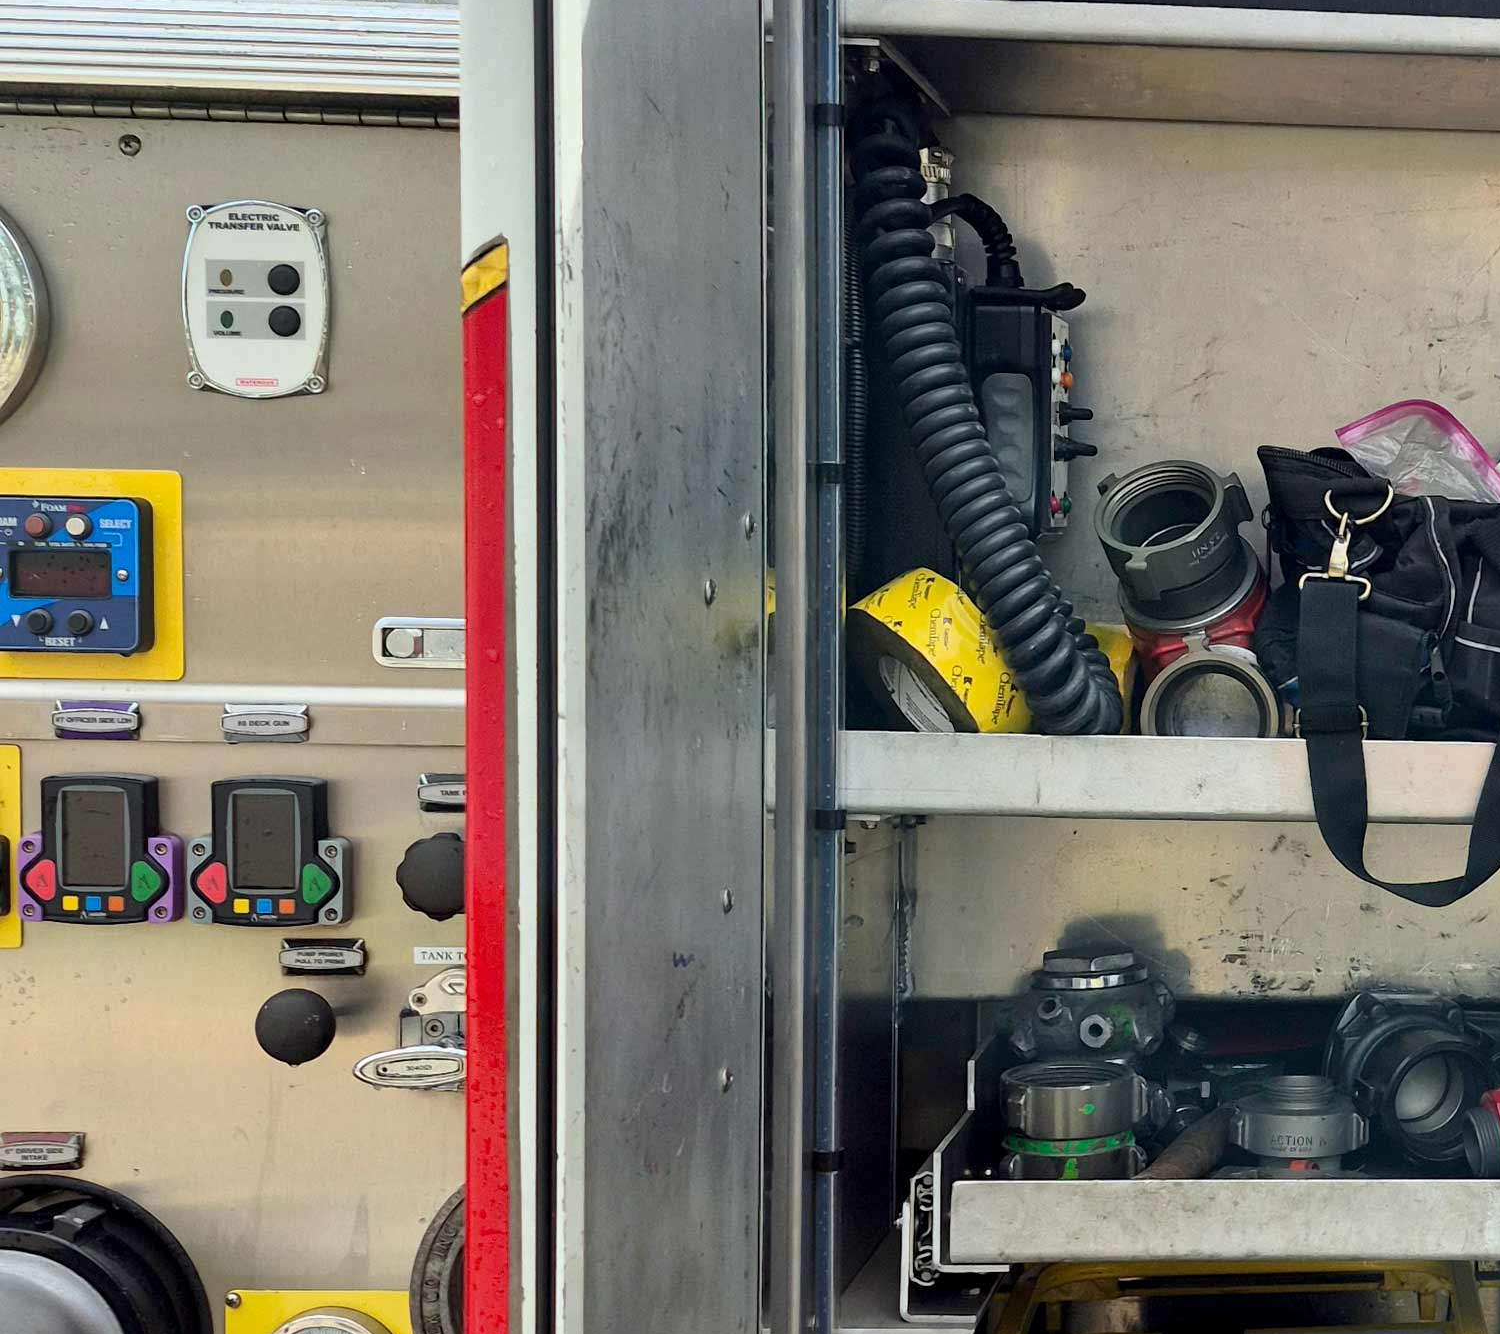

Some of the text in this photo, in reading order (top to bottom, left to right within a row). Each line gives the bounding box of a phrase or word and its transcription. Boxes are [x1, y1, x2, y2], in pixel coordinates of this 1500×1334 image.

[228, 212, 280, 221] ELECTRIC
[208, 222, 299, 231] TRANSFER VALVE
[99, 518, 132, 529] SELECT
[45, 637, 76, 647] RESET
[992, 671, 1011, 725] ChemTape
[420, 951, 453, 961] TANK
[1270, 1135, 1313, 1147] ACTION
